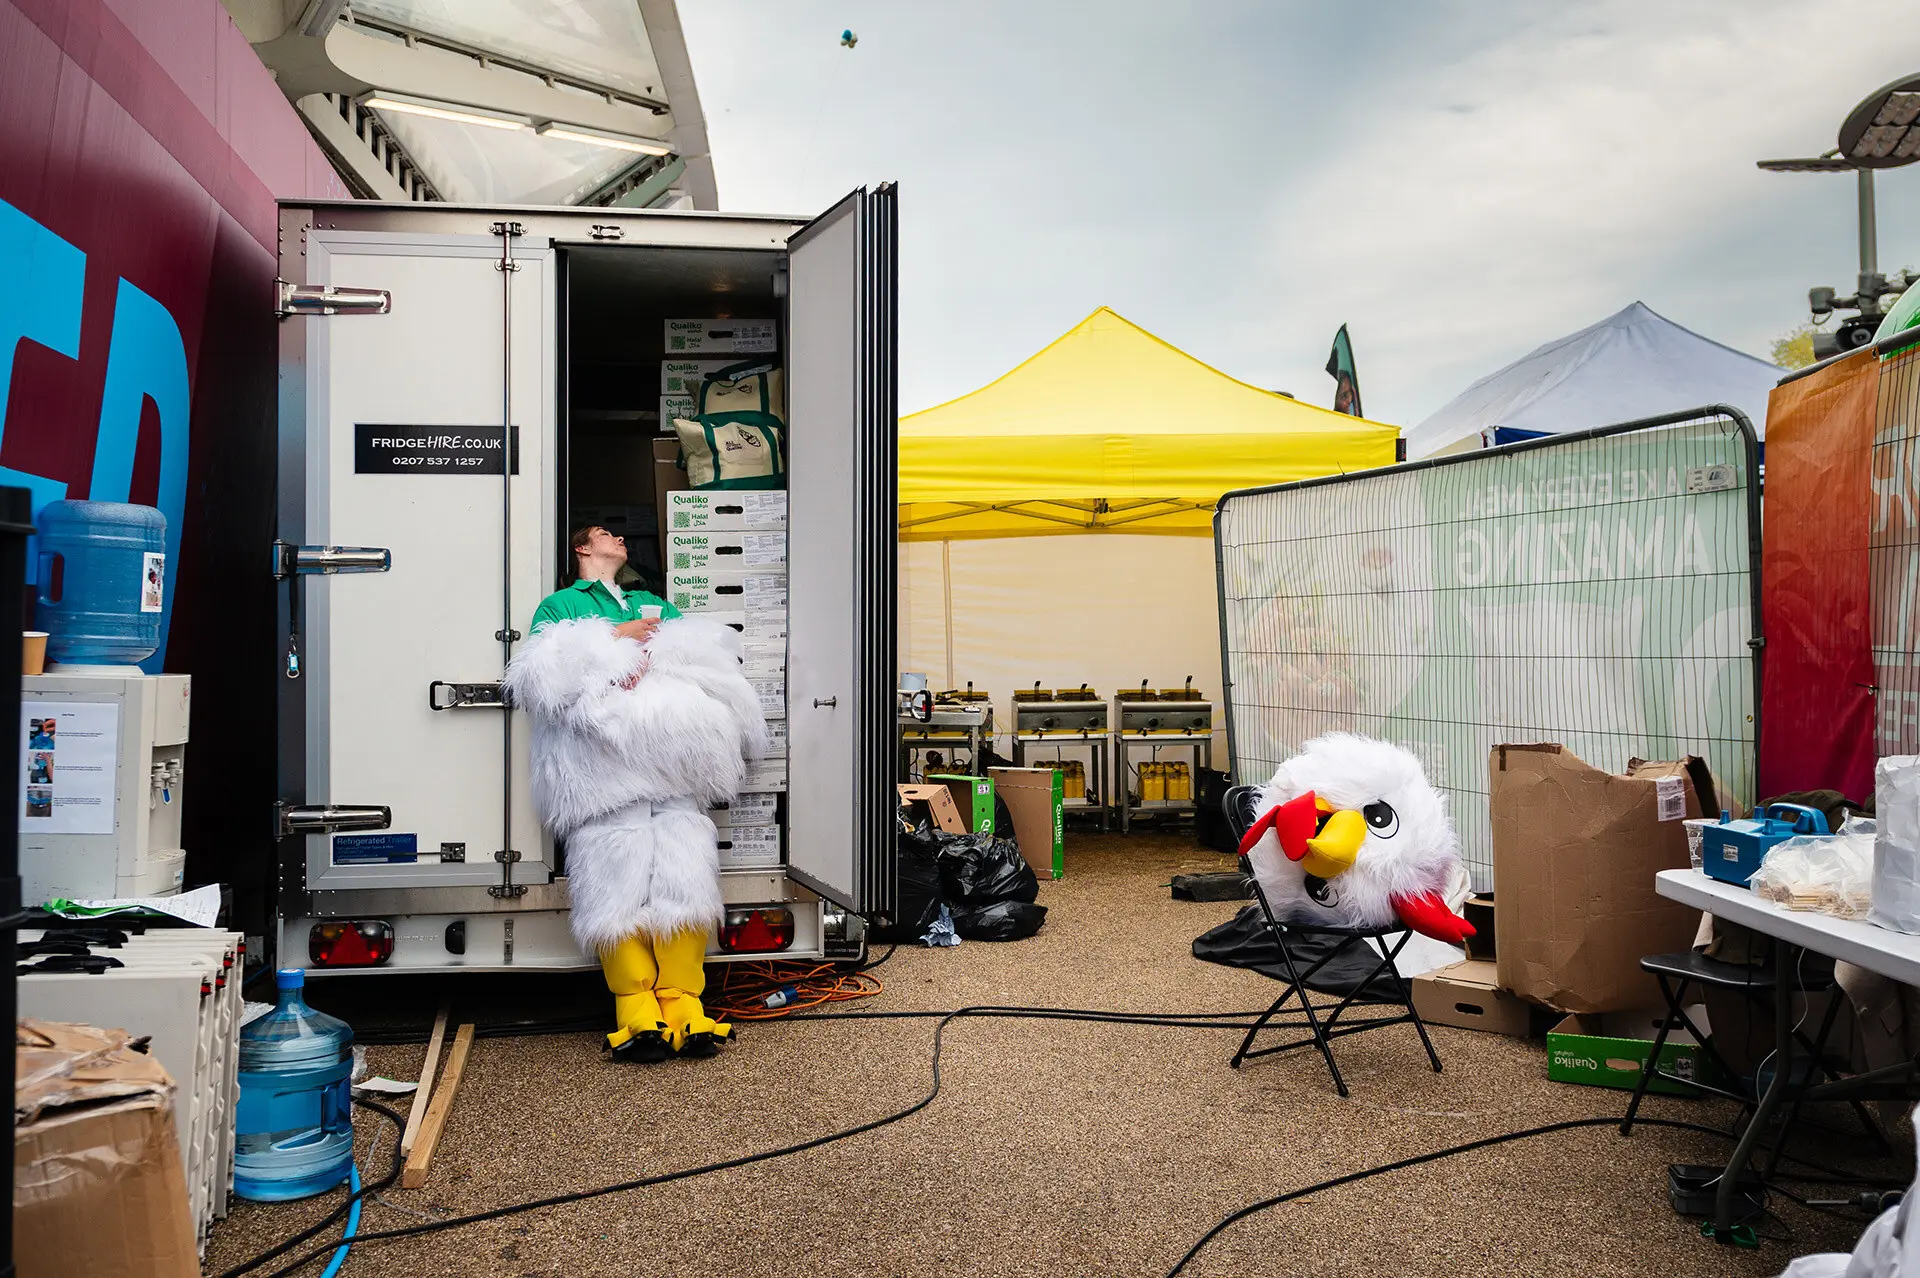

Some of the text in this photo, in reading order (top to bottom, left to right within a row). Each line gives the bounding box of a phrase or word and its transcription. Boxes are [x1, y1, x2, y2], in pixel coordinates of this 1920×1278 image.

[670, 322, 702, 330] Qualiko
[667, 364, 698, 372] Qualiko
[372, 435, 501, 449] FRIDGEHIRE.CO.UK
[392, 457, 484, 466] 0207 537 1257
[673, 495, 709, 506] Qualiko
[673, 536, 709, 546] Qualiko
[673, 576, 709, 587] Qualiko
[1055, 804, 1063, 844] Qualiko
[337, 835, 412, 847] Refrigerated Trailer
[1554, 1056, 1598, 1070] Qualiko
